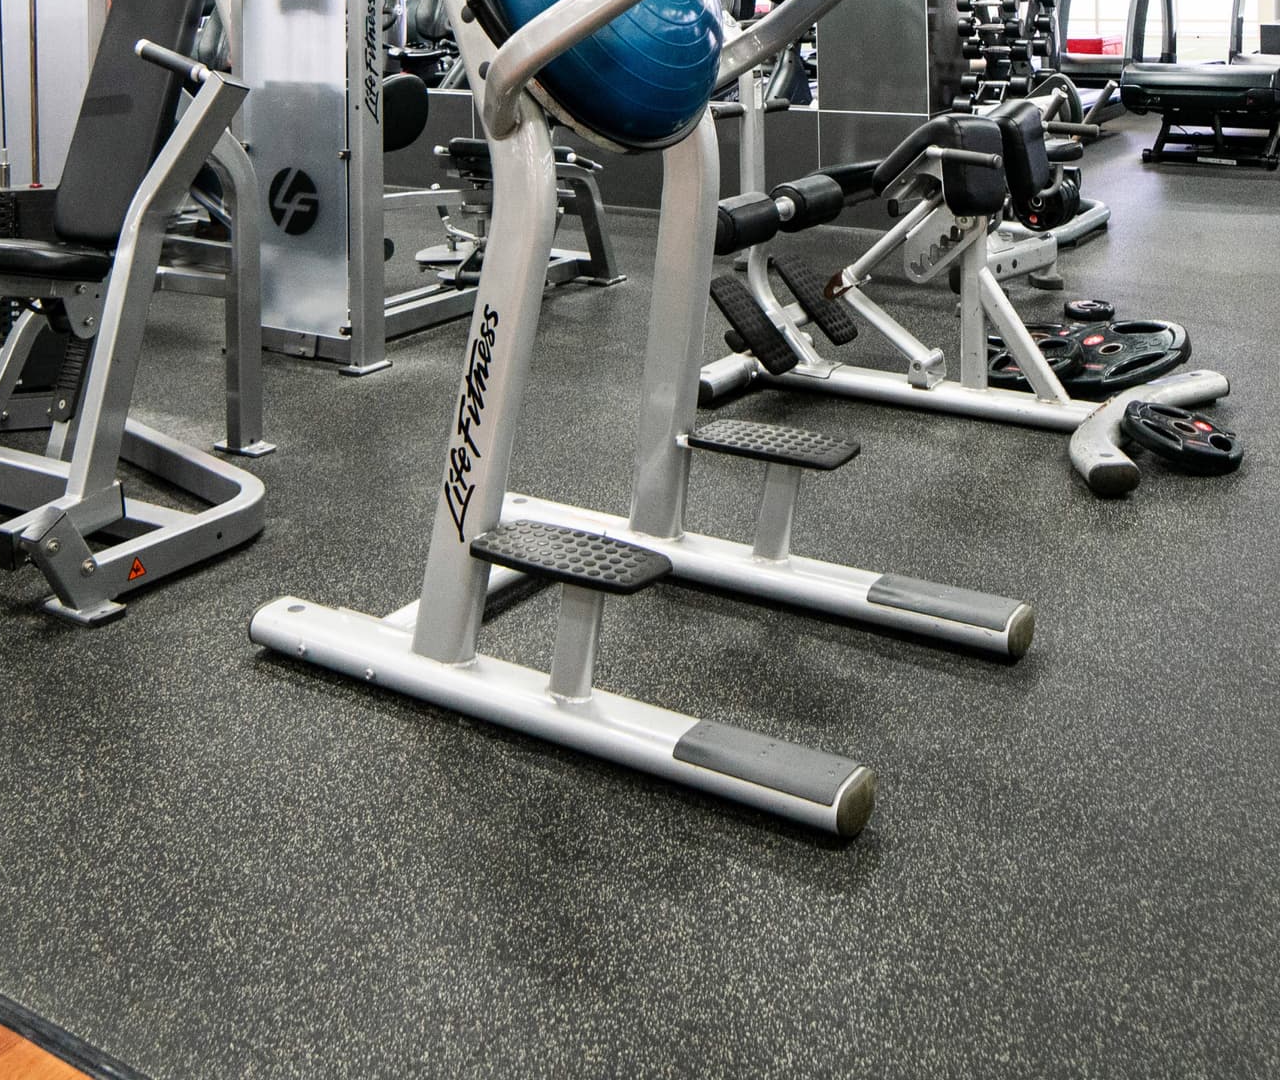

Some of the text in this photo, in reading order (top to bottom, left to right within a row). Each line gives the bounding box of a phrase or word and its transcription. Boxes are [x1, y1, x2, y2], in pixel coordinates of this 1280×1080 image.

[364, 75, 380, 125] Life
[444, 303, 499, 543] Life Fitness
